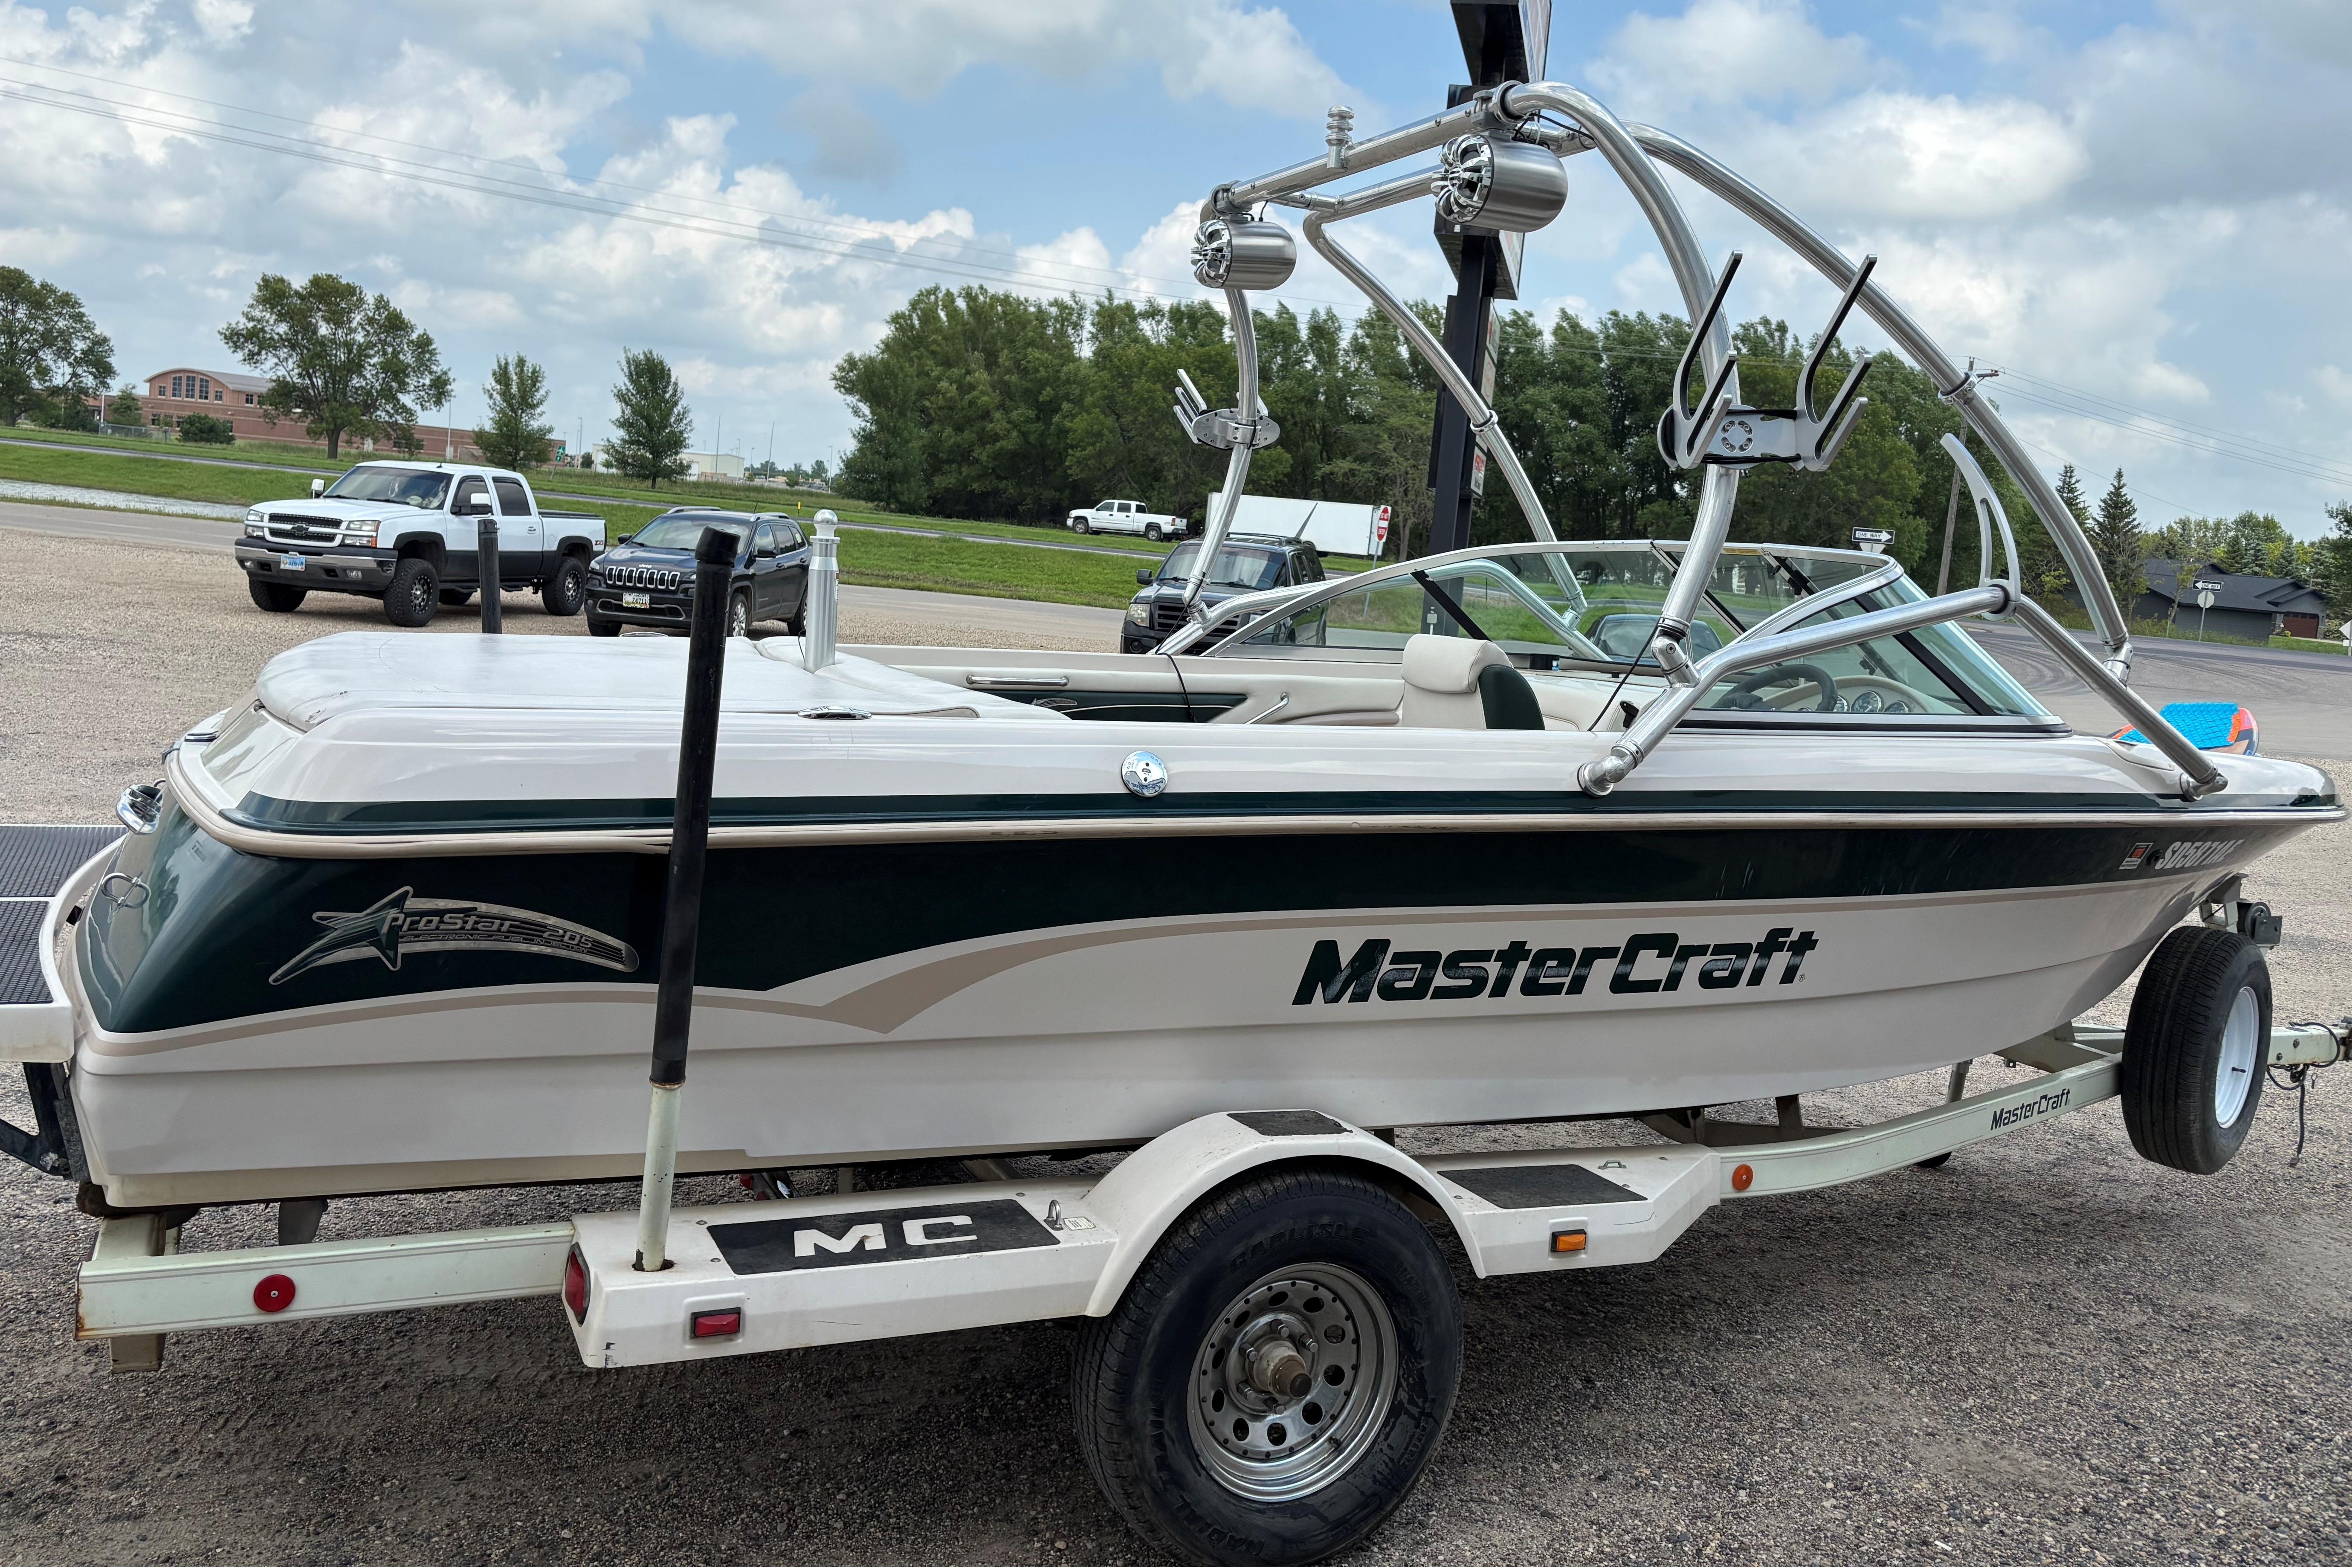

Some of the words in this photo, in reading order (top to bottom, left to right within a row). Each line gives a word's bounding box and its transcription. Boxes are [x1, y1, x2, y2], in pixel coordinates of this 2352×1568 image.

[381, 912, 521, 934] ProStar
[542, 926, 594, 948] 205
[400, 933, 491, 942] ELECTRONIC
[492, 935, 528, 943] FUEL
[532, 938, 589, 954] INJECTION
[1291, 927, 1819, 1006] MasterCraft
[1990, 1088, 2070, 1130] MasterCraft
[1229, 1222, 1370, 1269] CARLISLE
